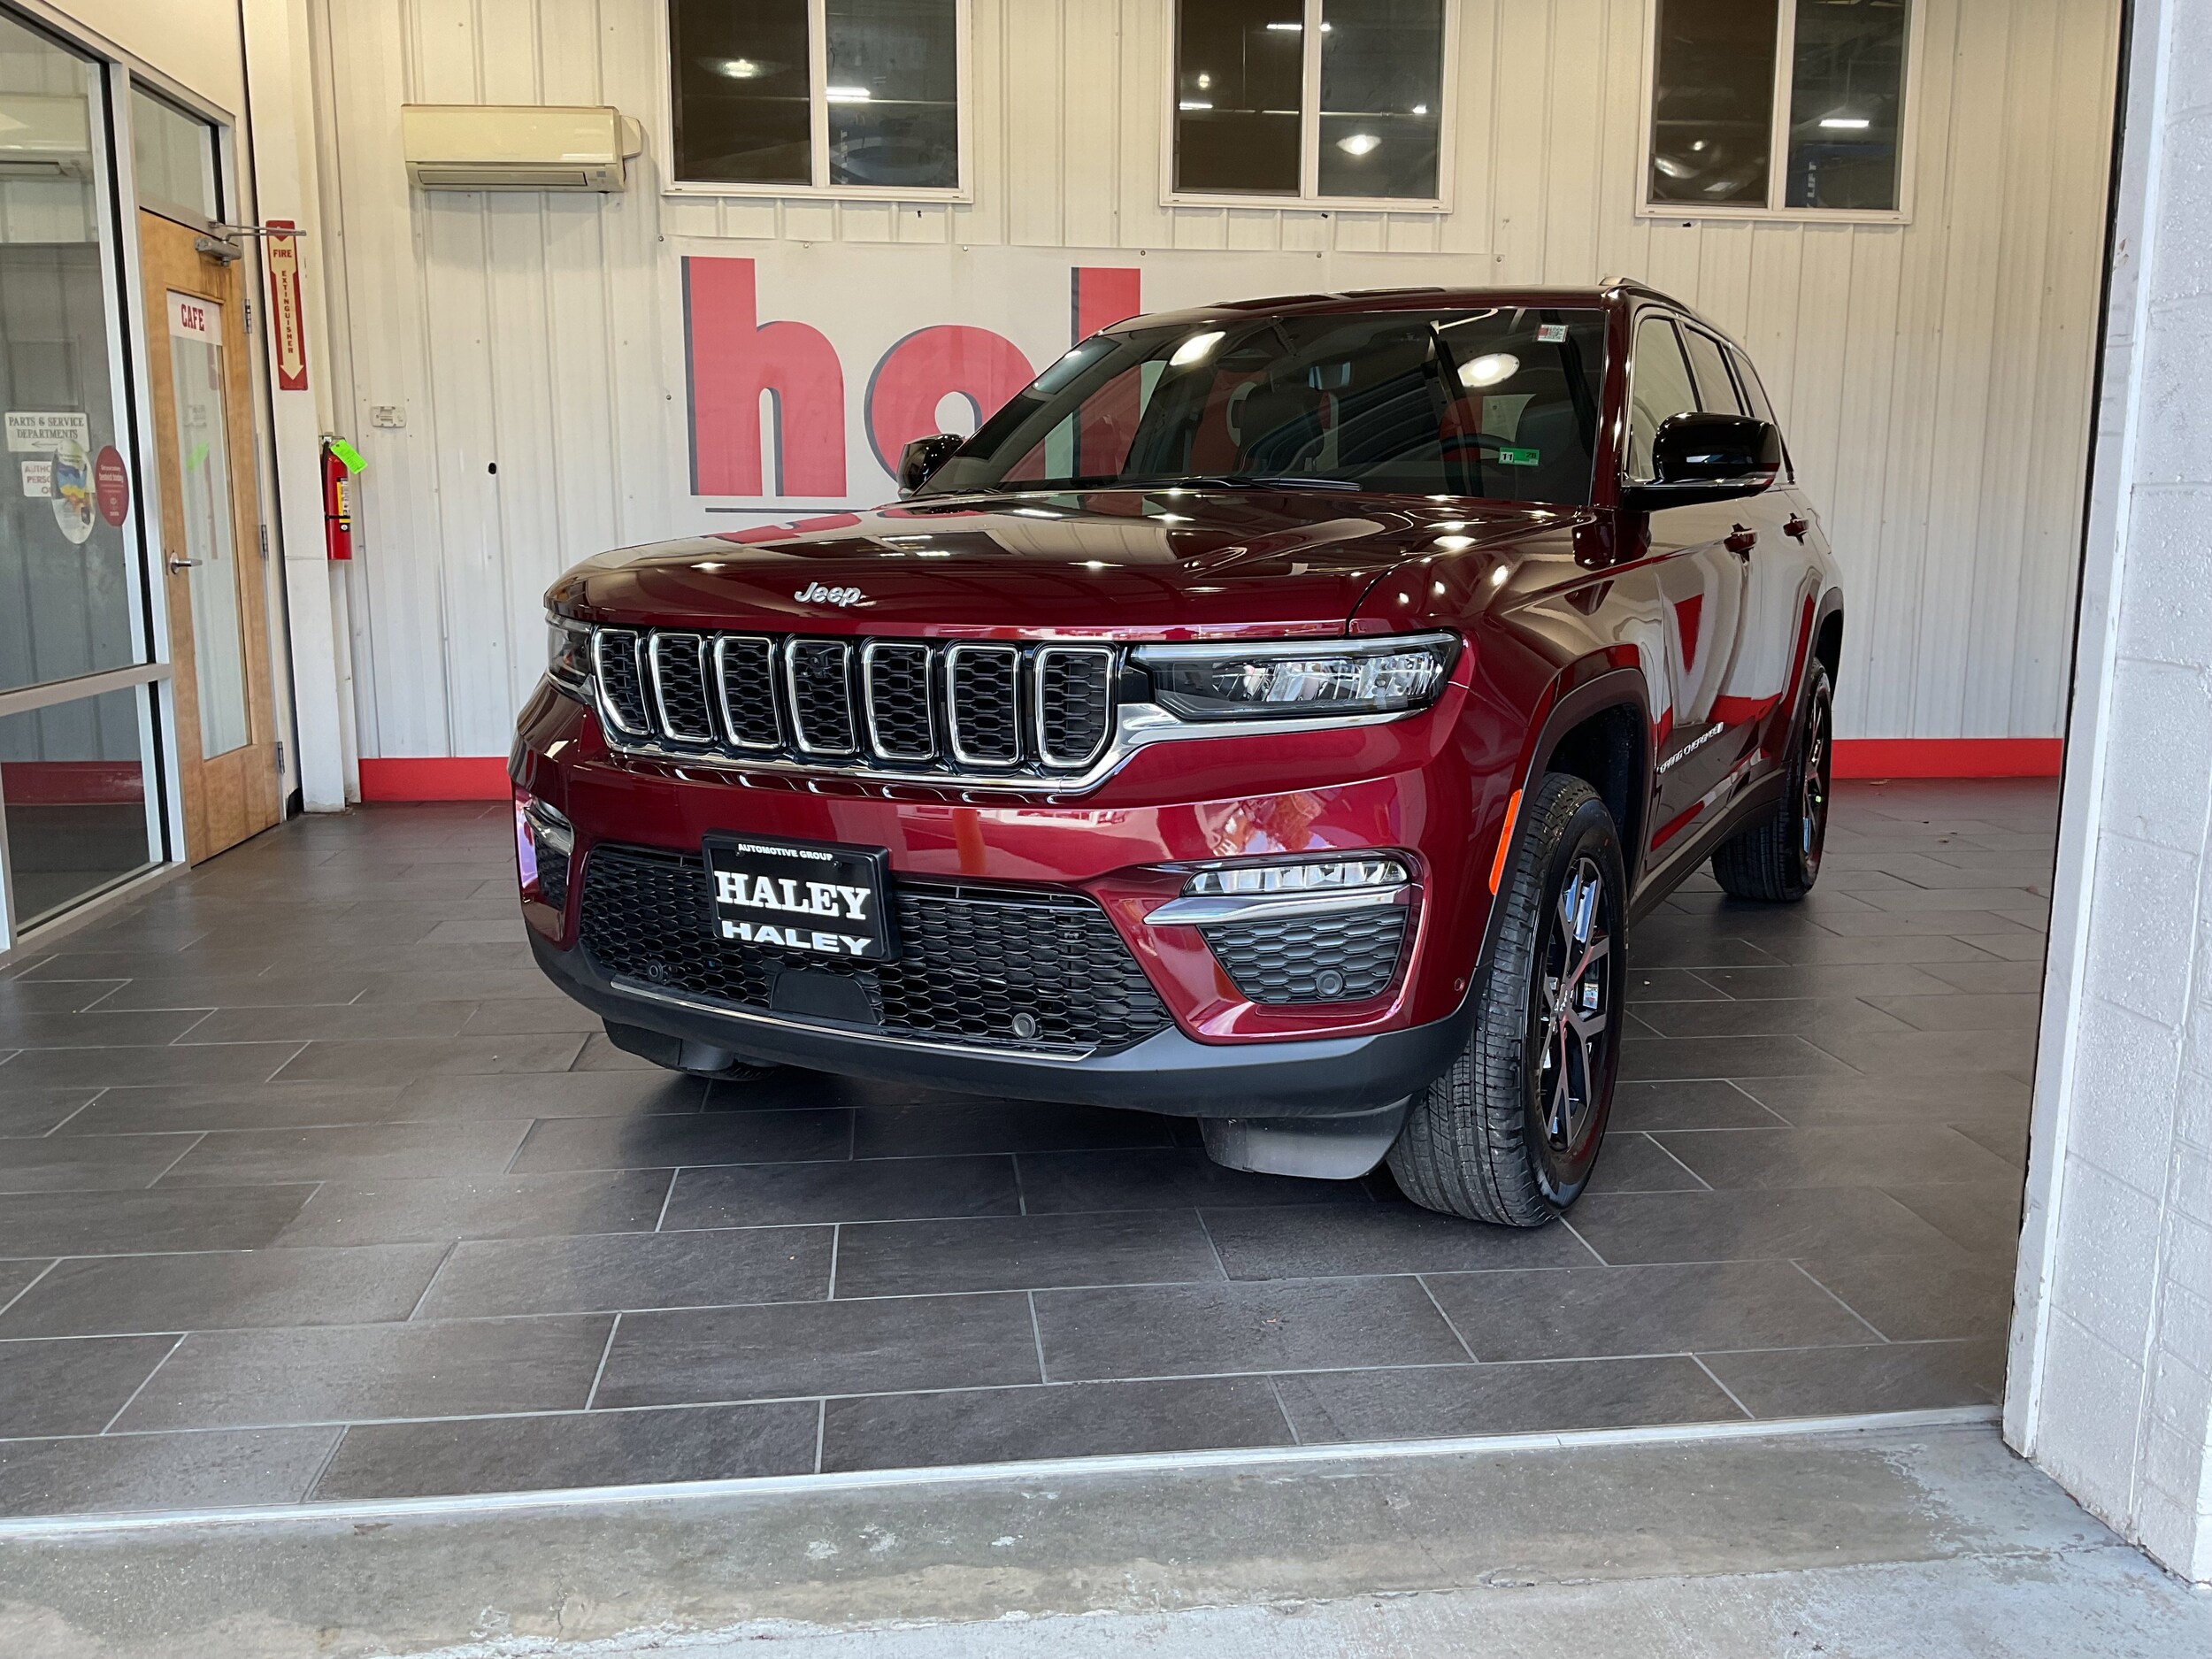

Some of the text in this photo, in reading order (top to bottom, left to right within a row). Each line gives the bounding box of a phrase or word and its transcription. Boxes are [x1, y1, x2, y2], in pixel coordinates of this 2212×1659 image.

[273, 249, 292, 258] FIRE
[180, 303, 204, 331] CAFE
[281, 270, 294, 354] EXTINGUISHER
[9, 417, 84, 426] PARTS & SERVICE
[17, 429, 78, 440] DEPARTMENTS
[794, 581, 861, 607] Jeep
[738, 843, 833, 861] AUTOMOTIVE GROUP
[714, 871, 871, 920] HALEY
[721, 920, 872, 956] HALEY
